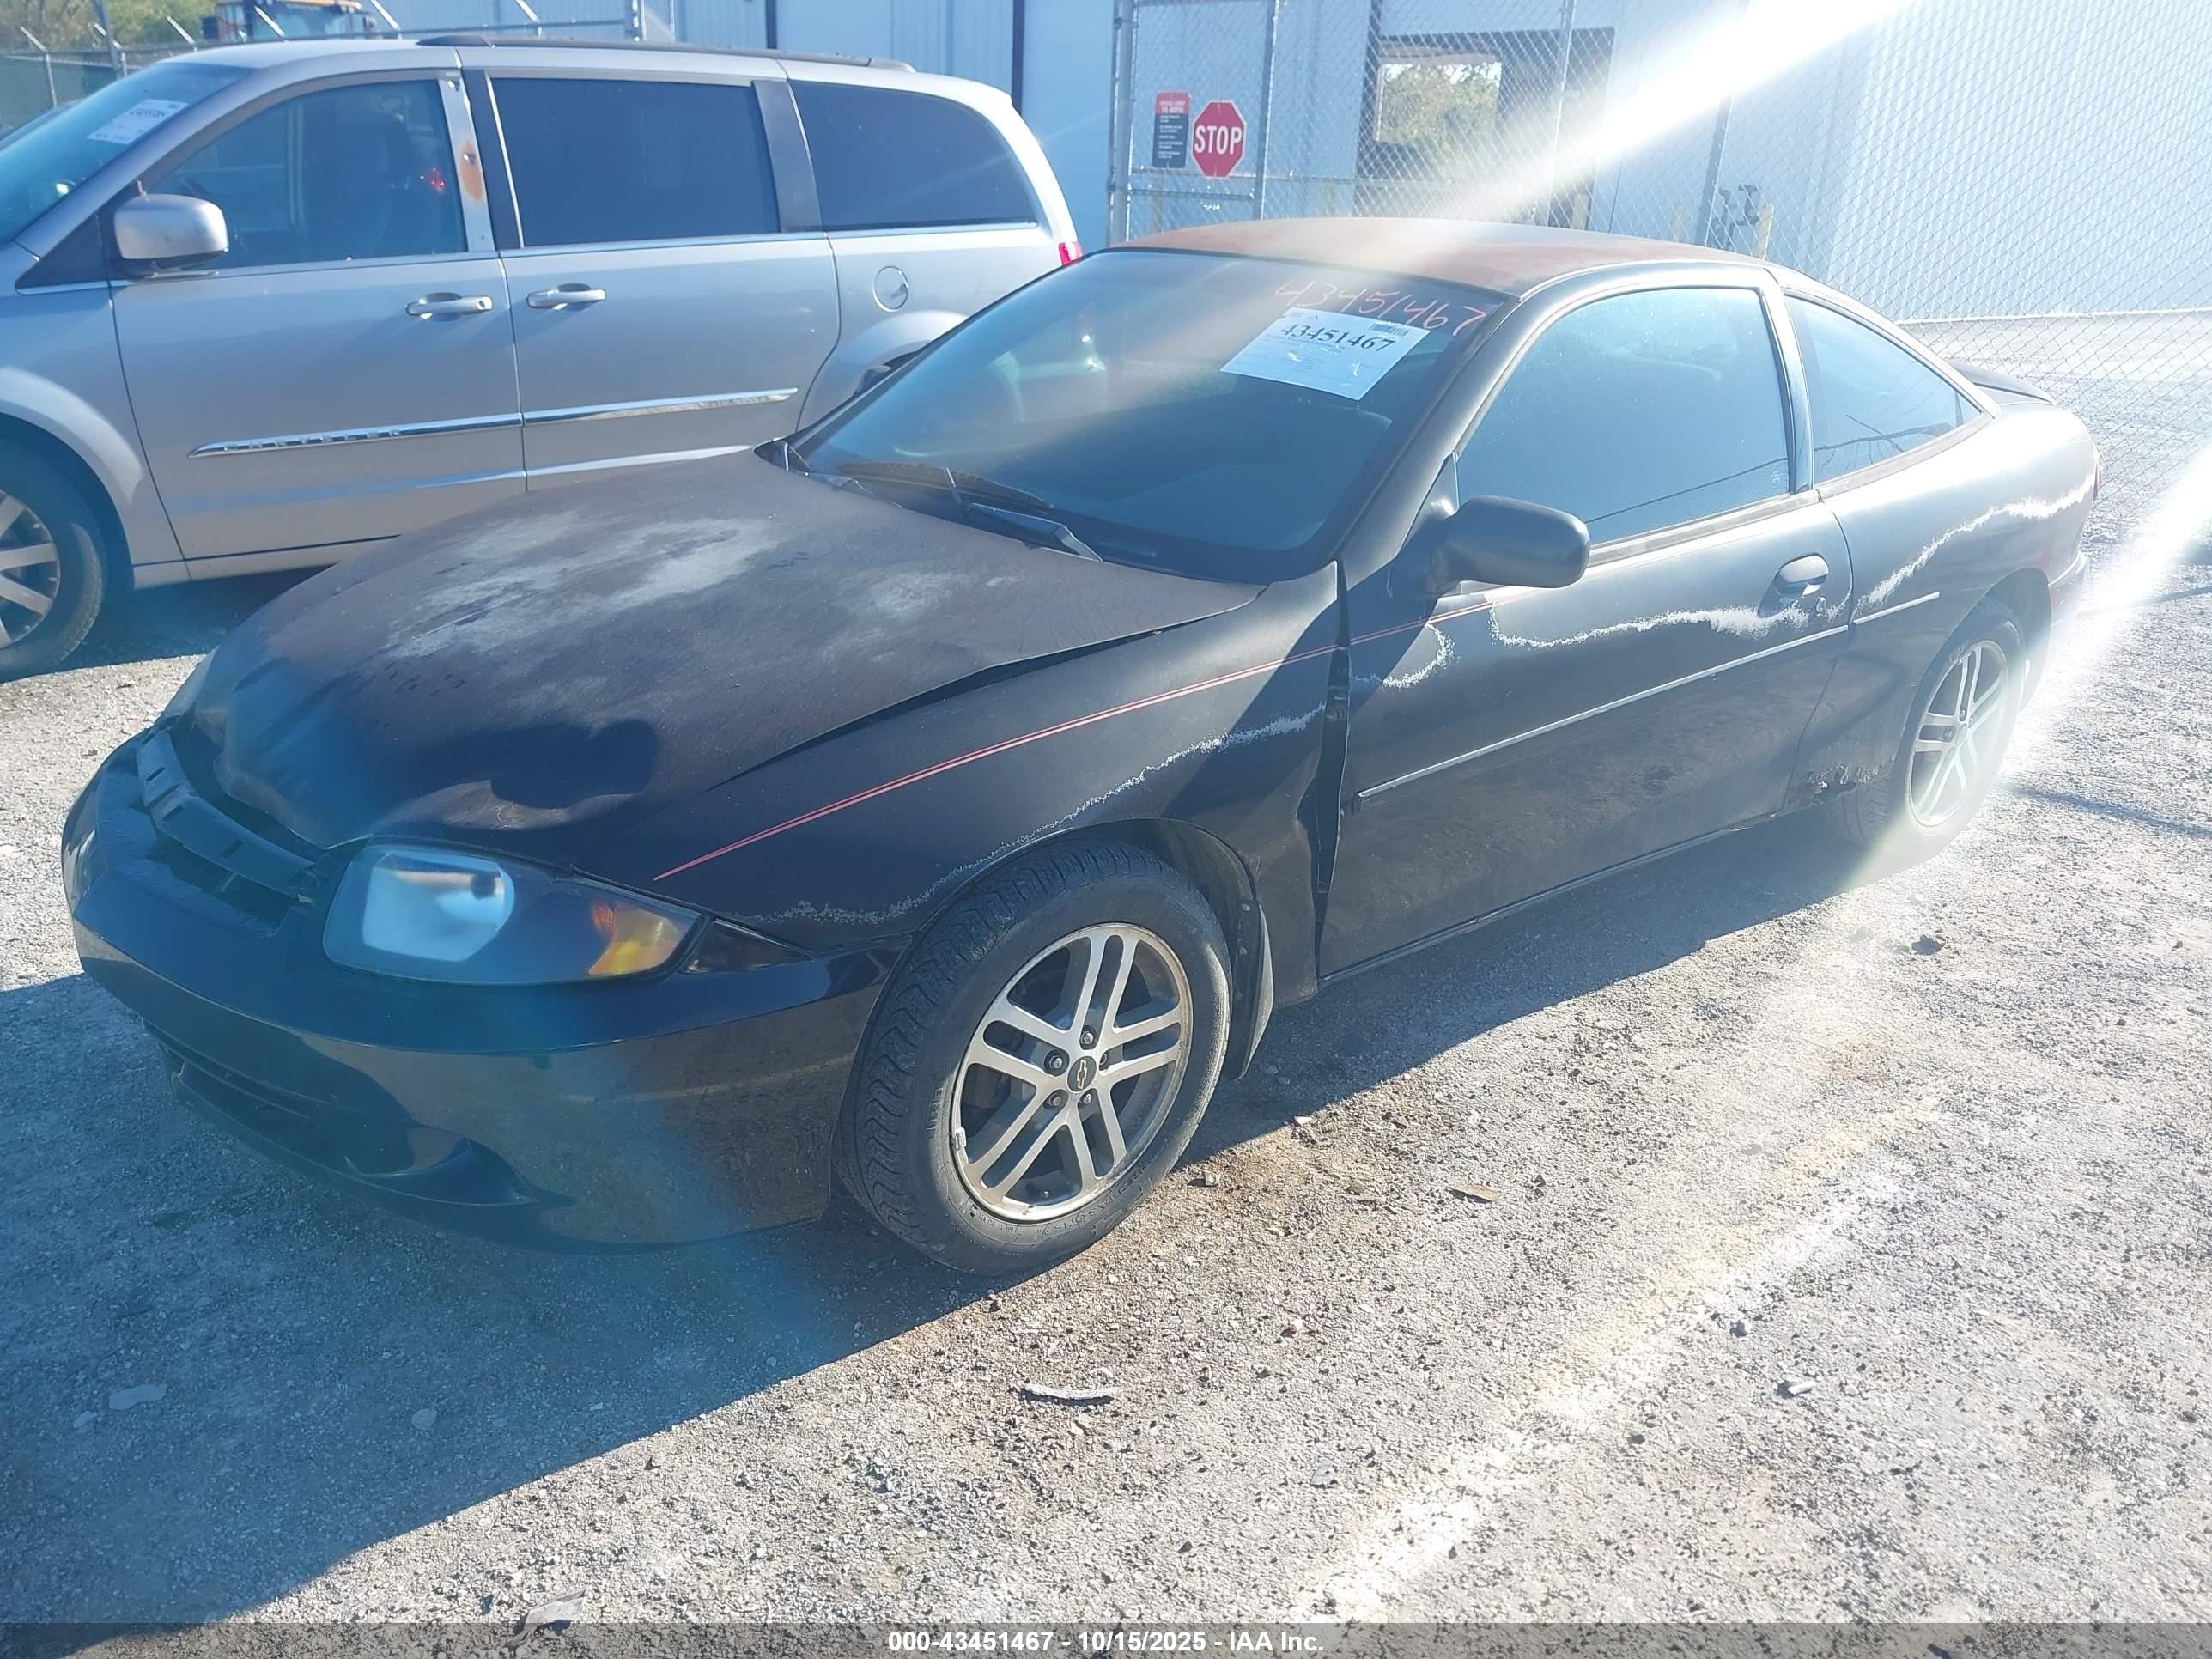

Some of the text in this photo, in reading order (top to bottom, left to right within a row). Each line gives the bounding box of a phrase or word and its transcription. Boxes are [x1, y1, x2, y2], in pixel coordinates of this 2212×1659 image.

[1194, 125, 1243, 155] STOP
[1274, 280, 1486, 336] 43451467
[1280, 324, 1395, 352] 43451467
